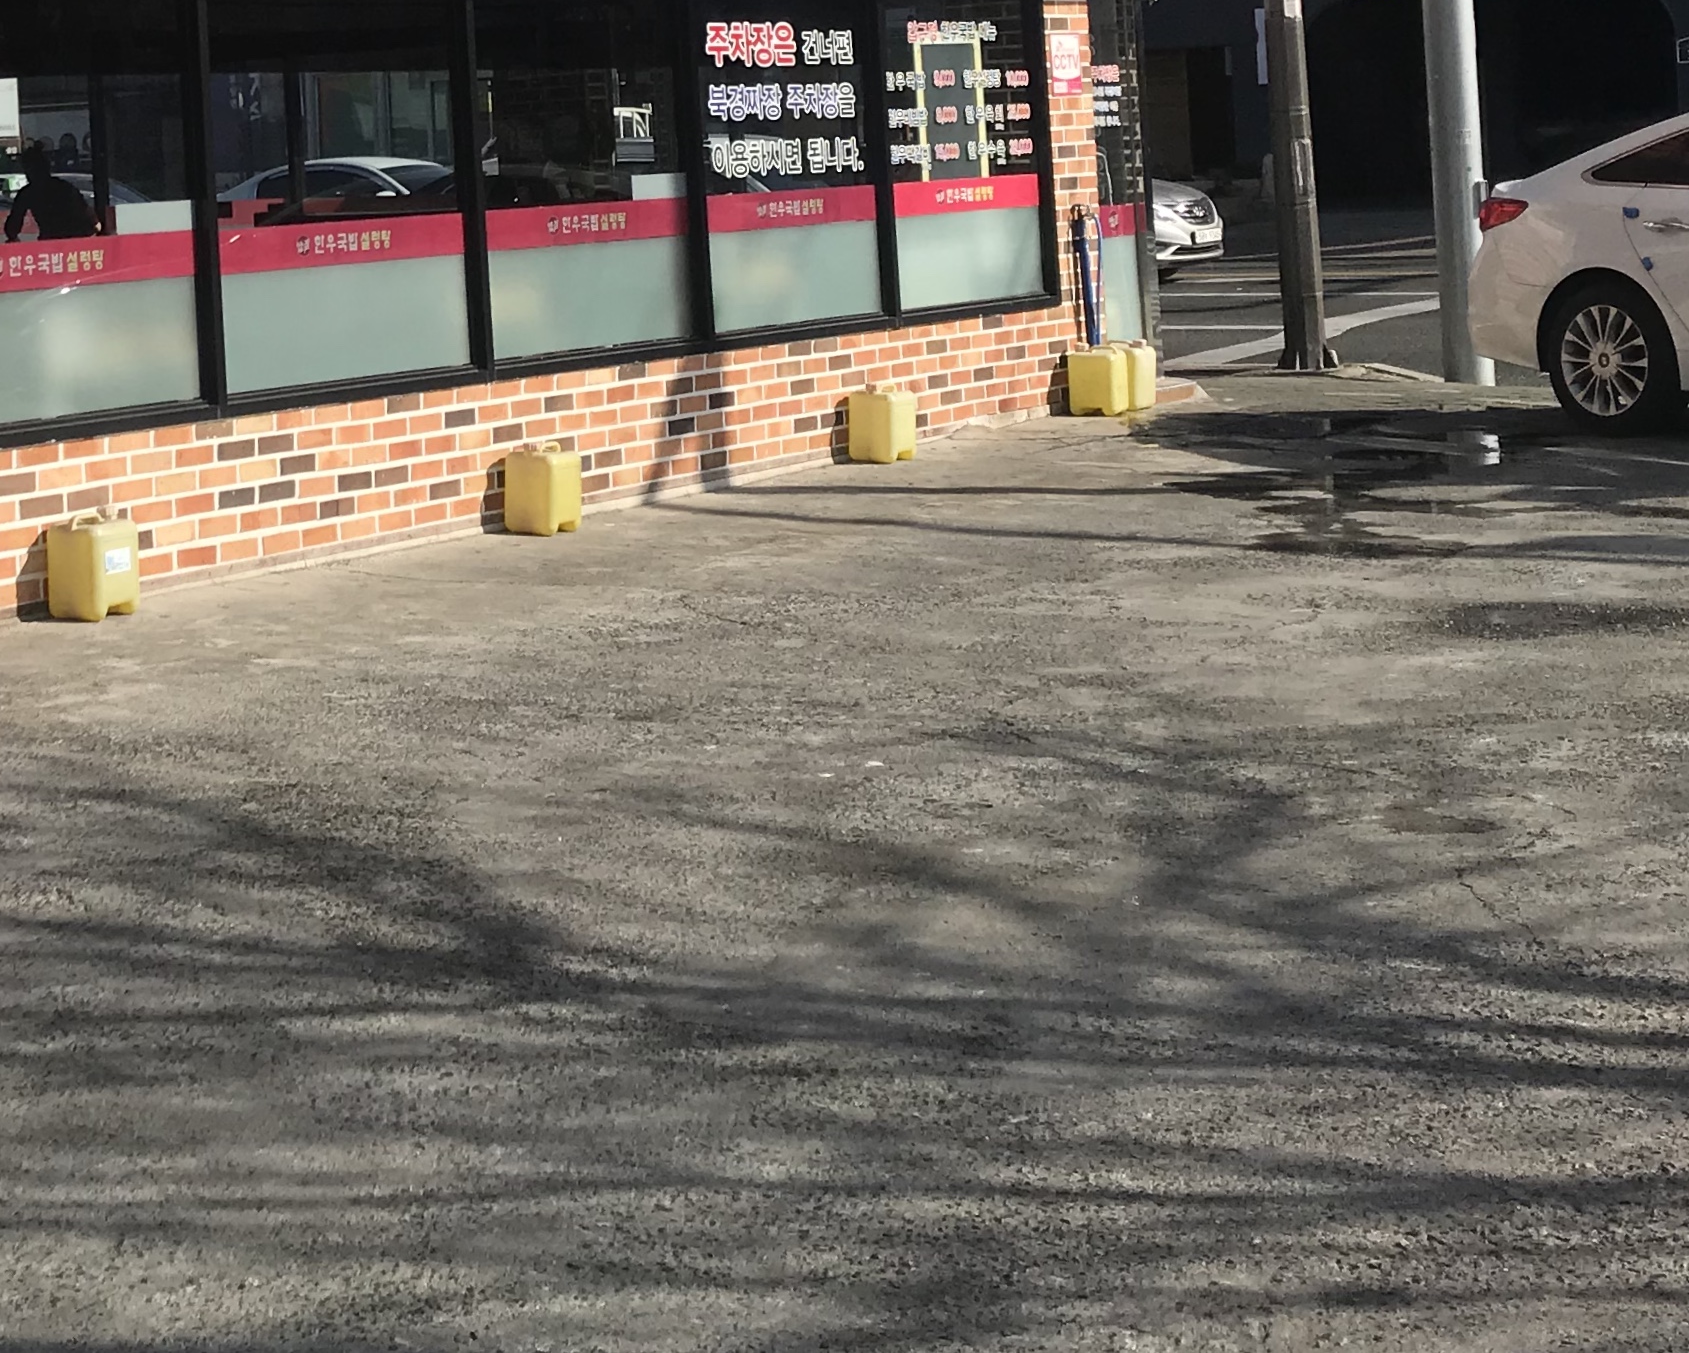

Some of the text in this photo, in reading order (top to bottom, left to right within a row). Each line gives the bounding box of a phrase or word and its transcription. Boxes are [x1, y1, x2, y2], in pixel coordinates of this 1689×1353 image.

[706, 21, 854, 68] 주차장은 건너편
[1053, 54, 1079, 70] CCTV
[708, 82, 856, 121] 북경짜장 주차장을
[713, 136, 864, 178] 이용하시면 됩니다.
